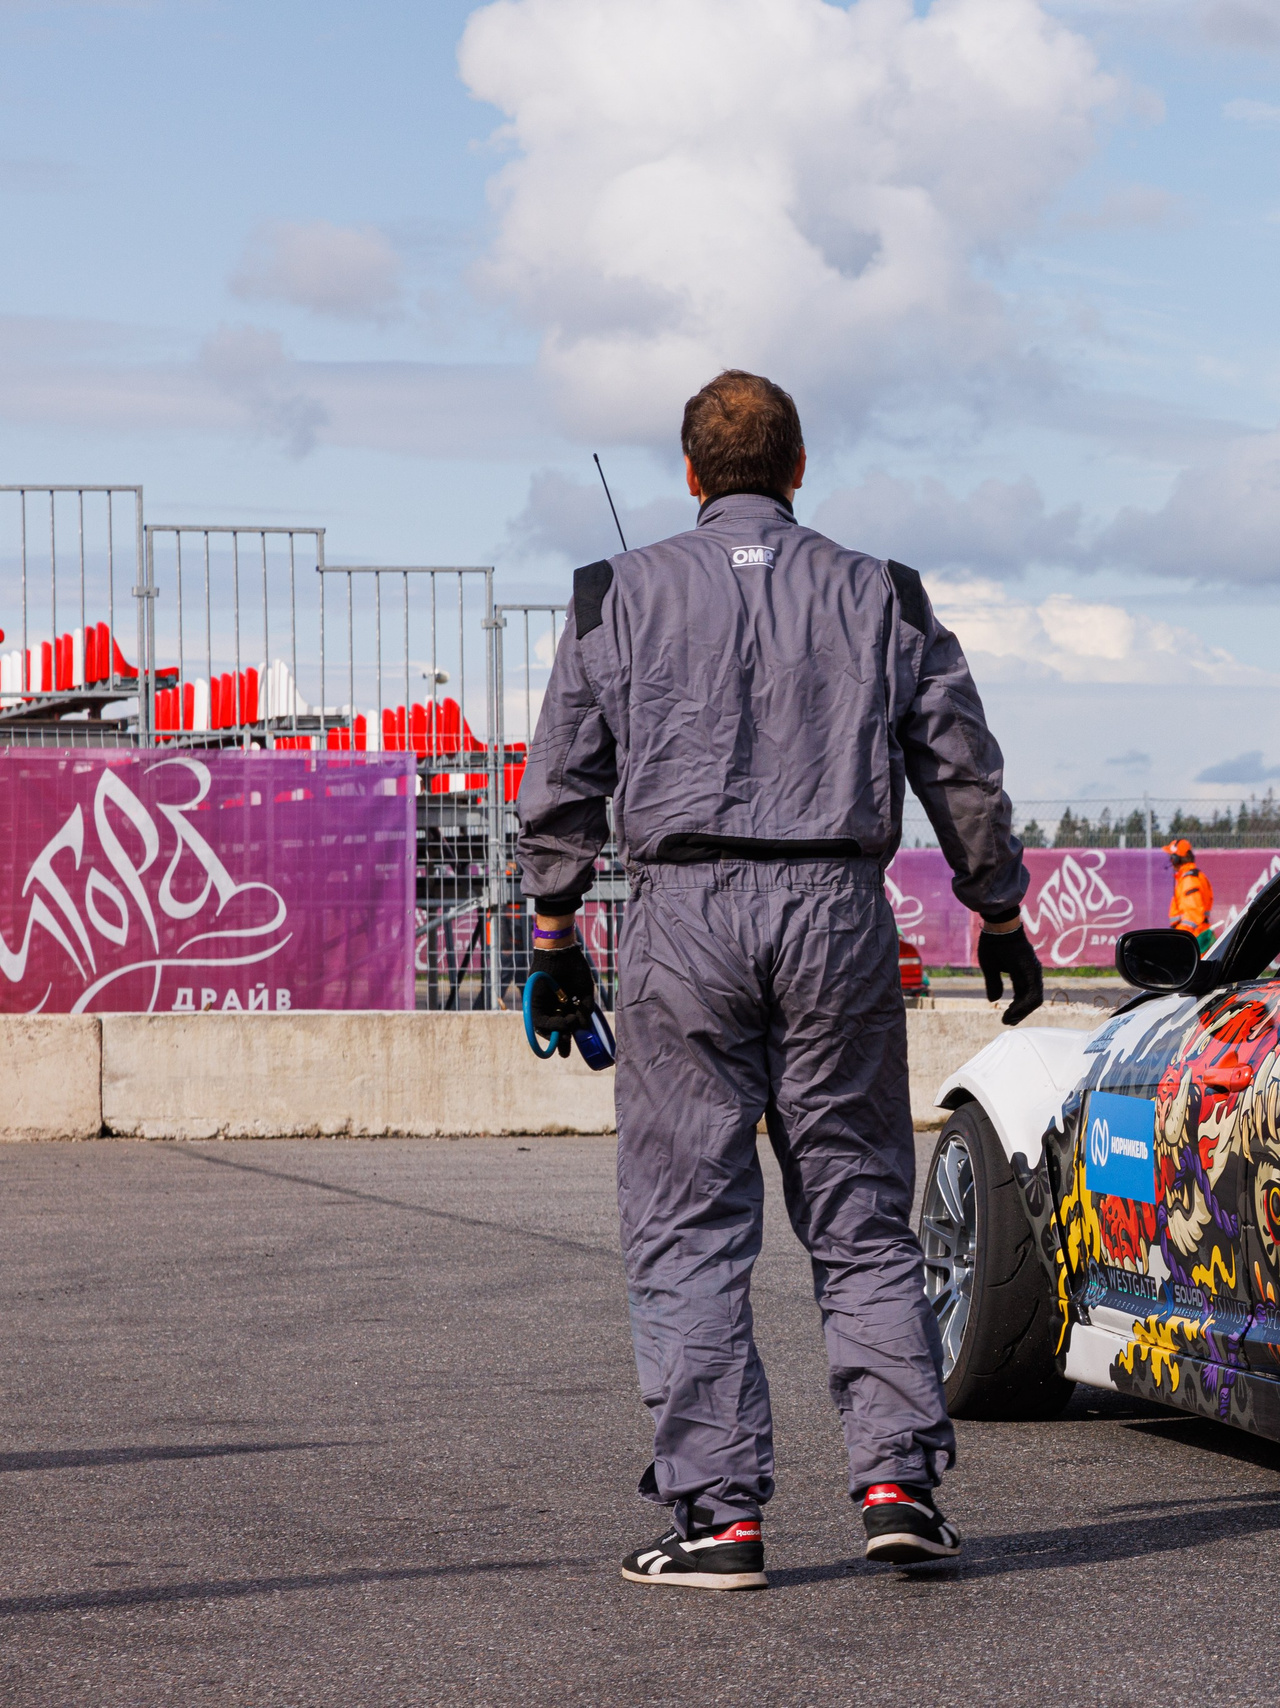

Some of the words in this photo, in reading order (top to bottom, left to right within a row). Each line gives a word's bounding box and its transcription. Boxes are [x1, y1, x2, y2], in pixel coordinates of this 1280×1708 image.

[732, 548, 774, 564] OMP
[1090, 934, 1121, 946] ДРА
[172, 983, 291, 1011] ДРАЙВ
[1111, 1136, 1148, 1160] НОРНИКЕЛЬ
[1106, 1268, 1157, 1300] WESTGATE
[736, 1529, 761, 1537] Reebo
